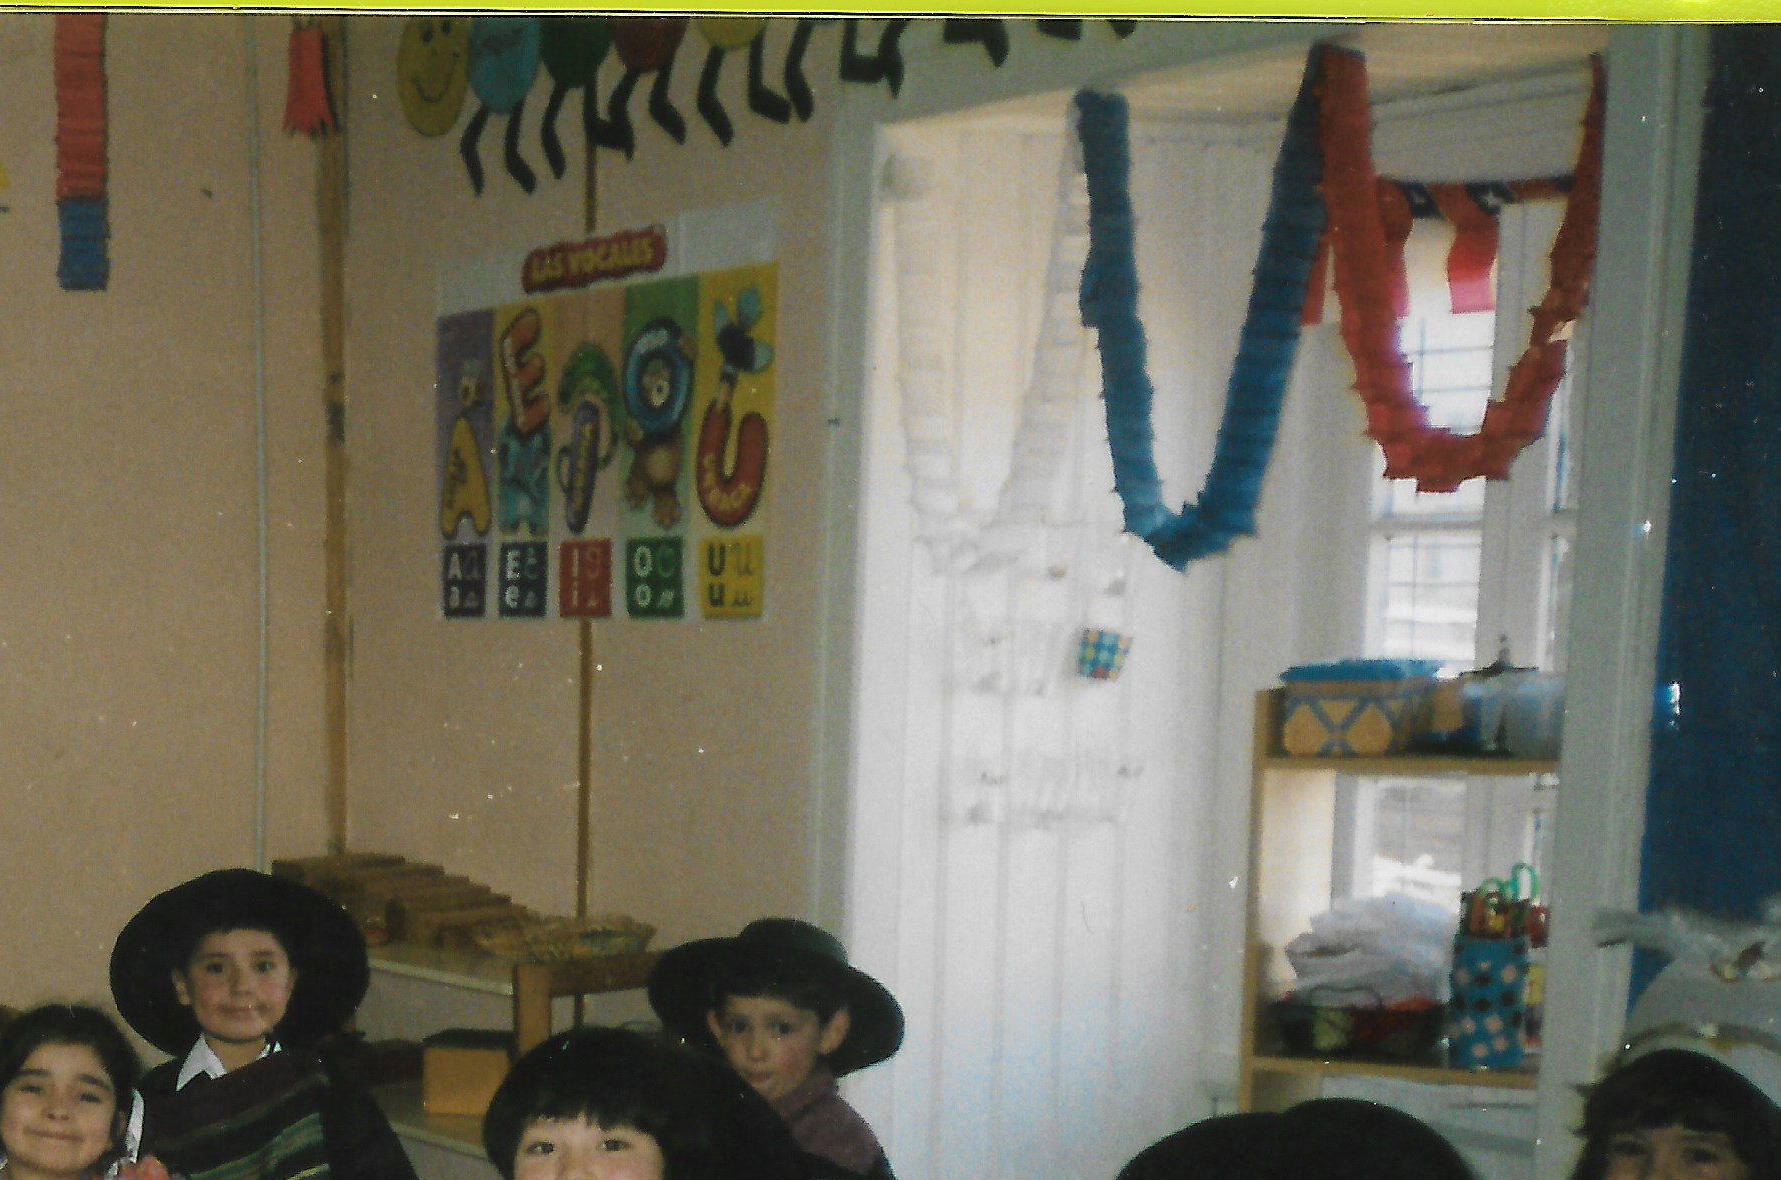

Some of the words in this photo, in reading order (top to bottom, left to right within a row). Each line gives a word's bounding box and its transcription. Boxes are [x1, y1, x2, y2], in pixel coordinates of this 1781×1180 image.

[530, 253, 564, 284] LAS
[568, 238, 655, 276] VOCALES
[448, 552, 463, 580] A
[505, 549, 521, 579] E
[634, 545, 653, 578] O
[708, 542, 726, 576] U
[505, 585, 520, 609] e
[634, 584, 652, 608] o
